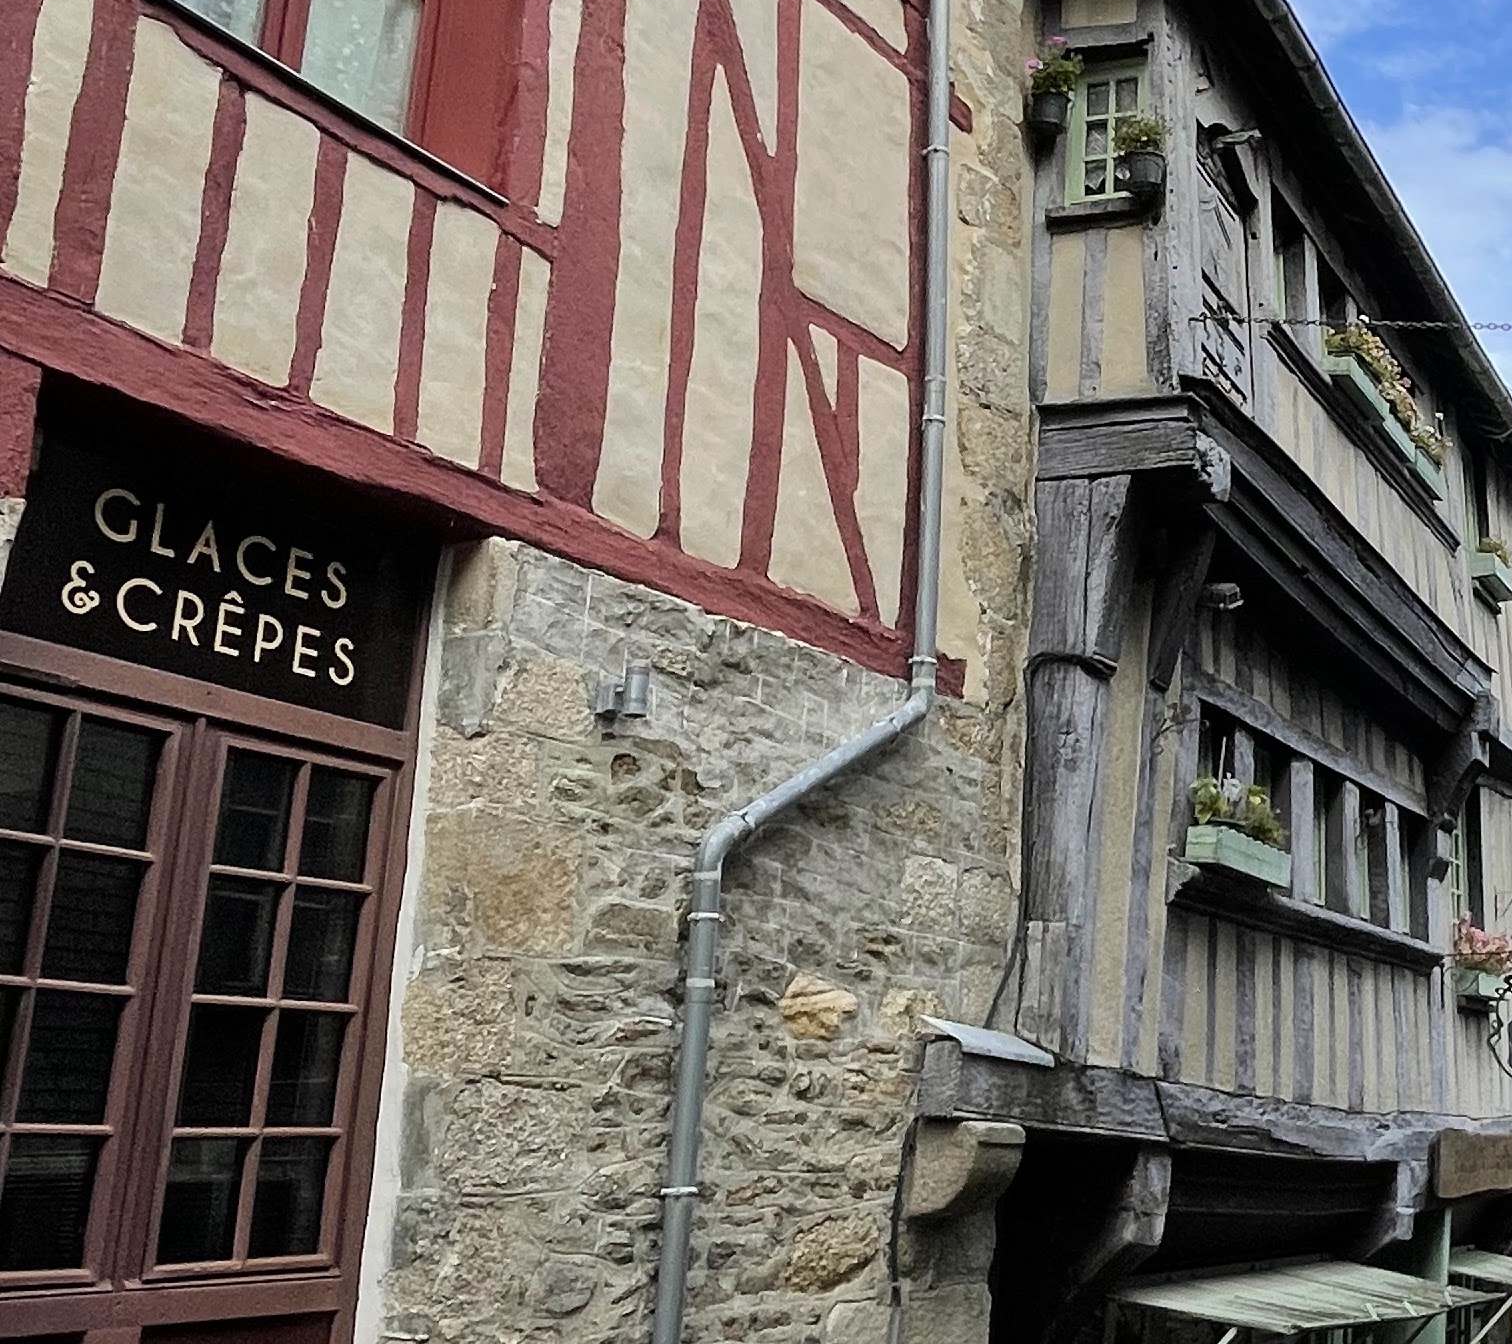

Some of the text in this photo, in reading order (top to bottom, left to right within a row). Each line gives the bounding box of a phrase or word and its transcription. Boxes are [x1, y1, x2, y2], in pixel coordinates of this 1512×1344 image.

[94, 488, 348, 609] GLACES
[61, 560, 356, 686] & CRÊPES
